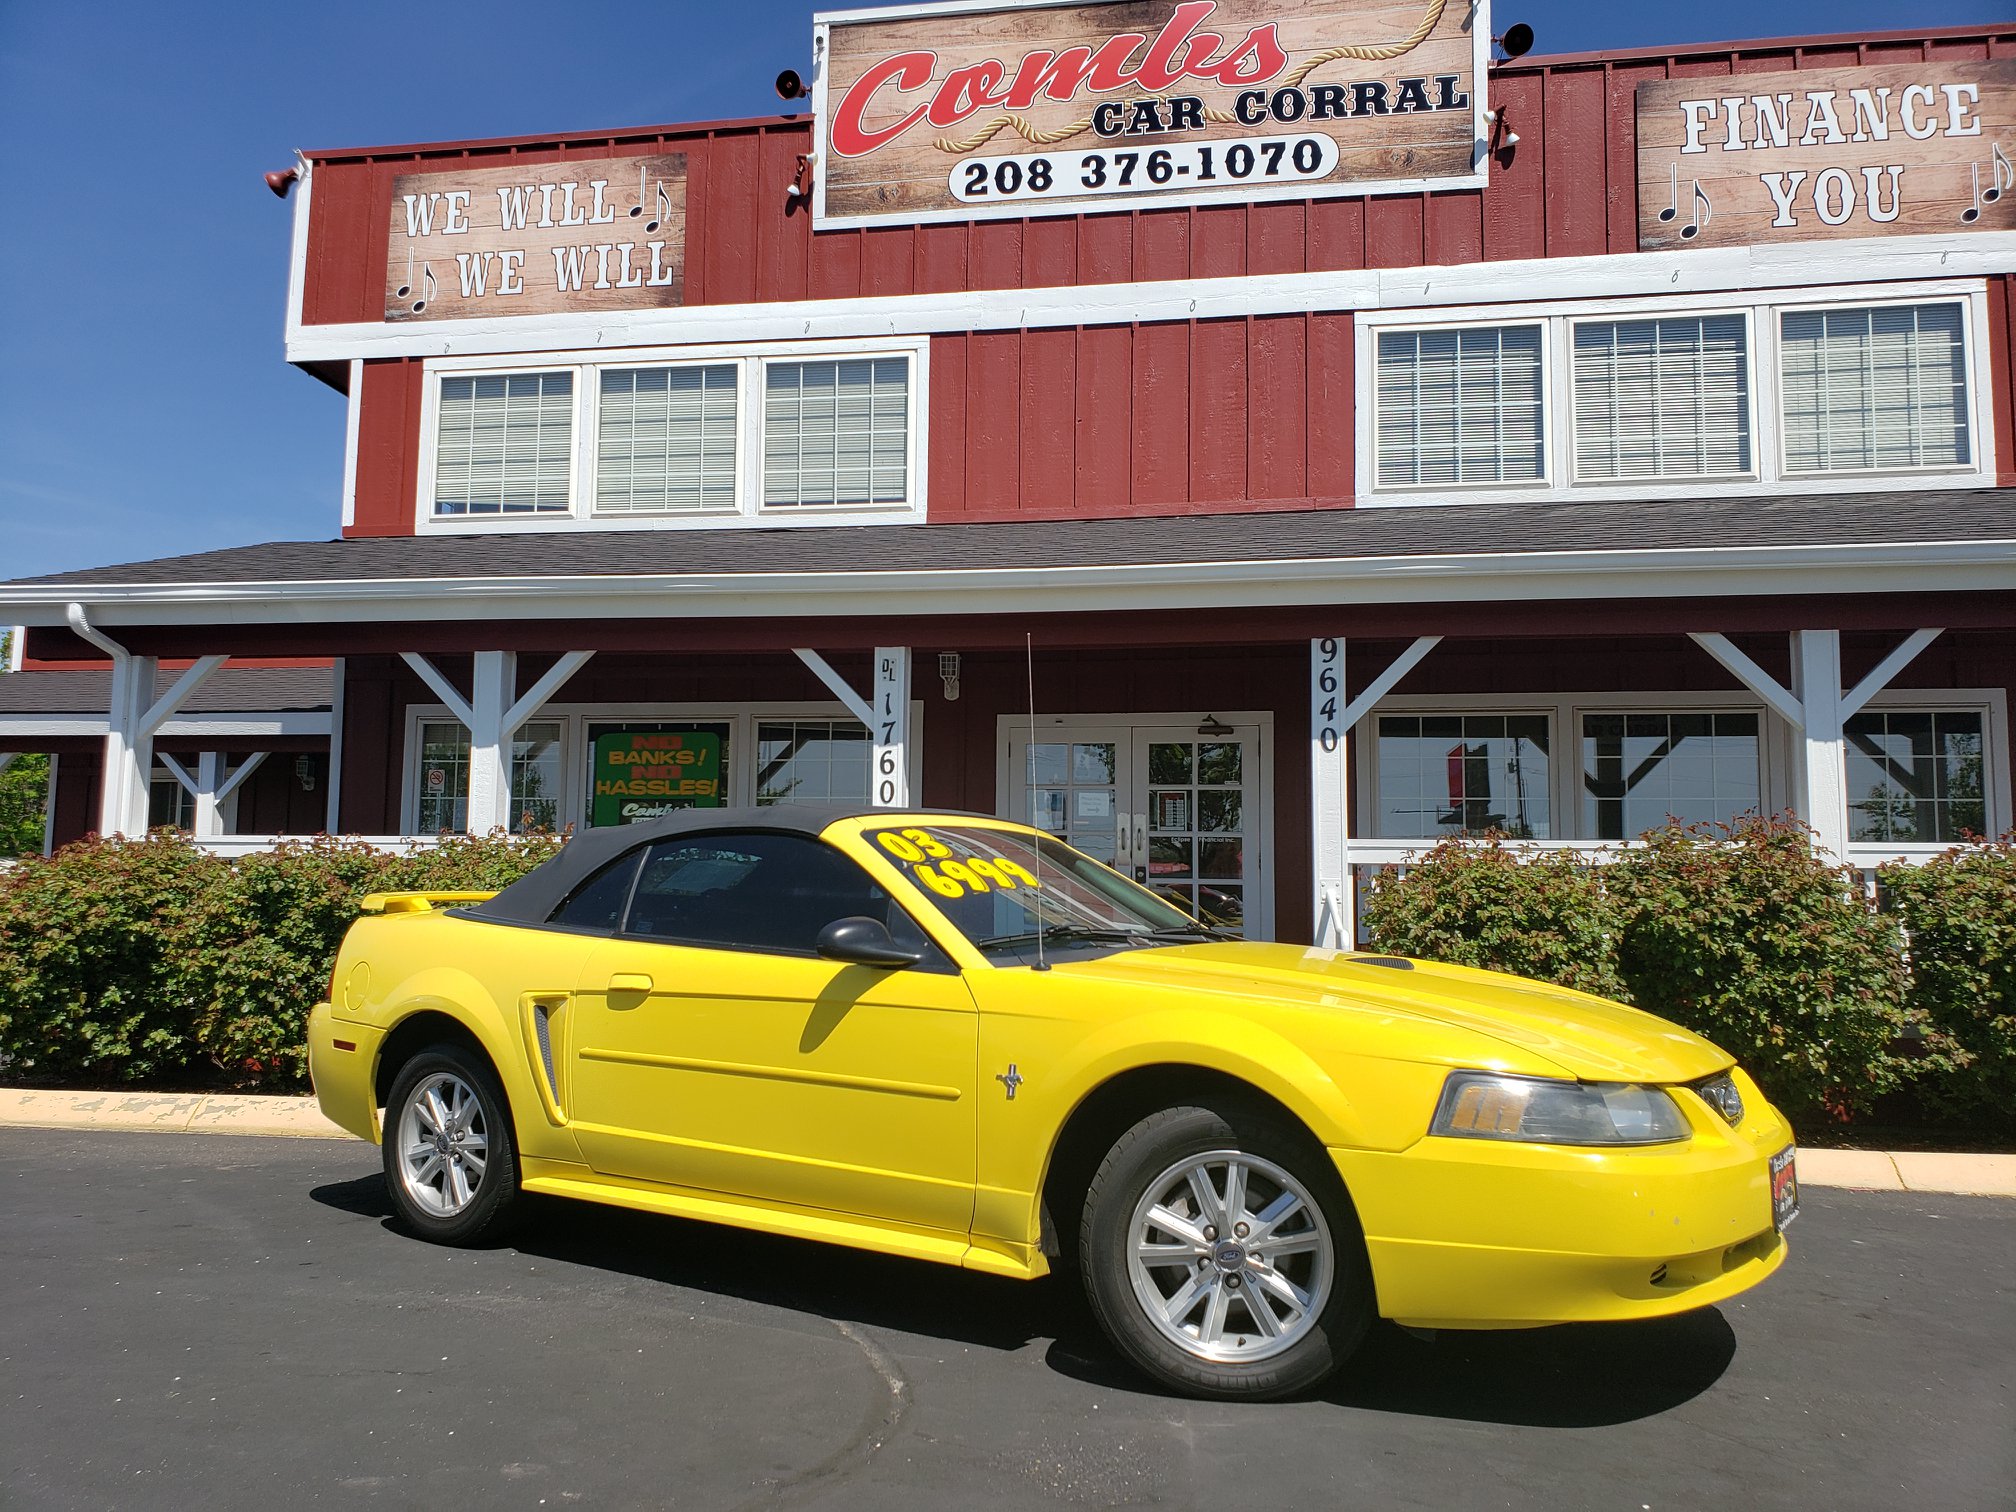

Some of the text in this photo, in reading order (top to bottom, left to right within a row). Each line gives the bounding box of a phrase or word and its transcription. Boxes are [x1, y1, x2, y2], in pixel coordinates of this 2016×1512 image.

[831, 0, 1288, 157] Combs
[1092, 75, 1471, 138] CAR CORRAL
[1679, 83, 1982, 155] FINANCE
[964, 138, 1324, 196] 208 376-1070
[403, 179, 616, 237] WE WILL
[1760, 165, 1905, 228] YOU
[456, 241, 673, 298] WE WILL
[1320, 638, 1338, 753] 9640
[632, 735, 682, 749] NO
[880, 692, 896, 804] 1760
[596, 779, 718, 797] HASSLES!
[631, 765, 682, 779] NO
[622, 802, 680, 817] Comb
[876, 829, 954, 863] 03
[913, 857, 1043, 899] 6999
